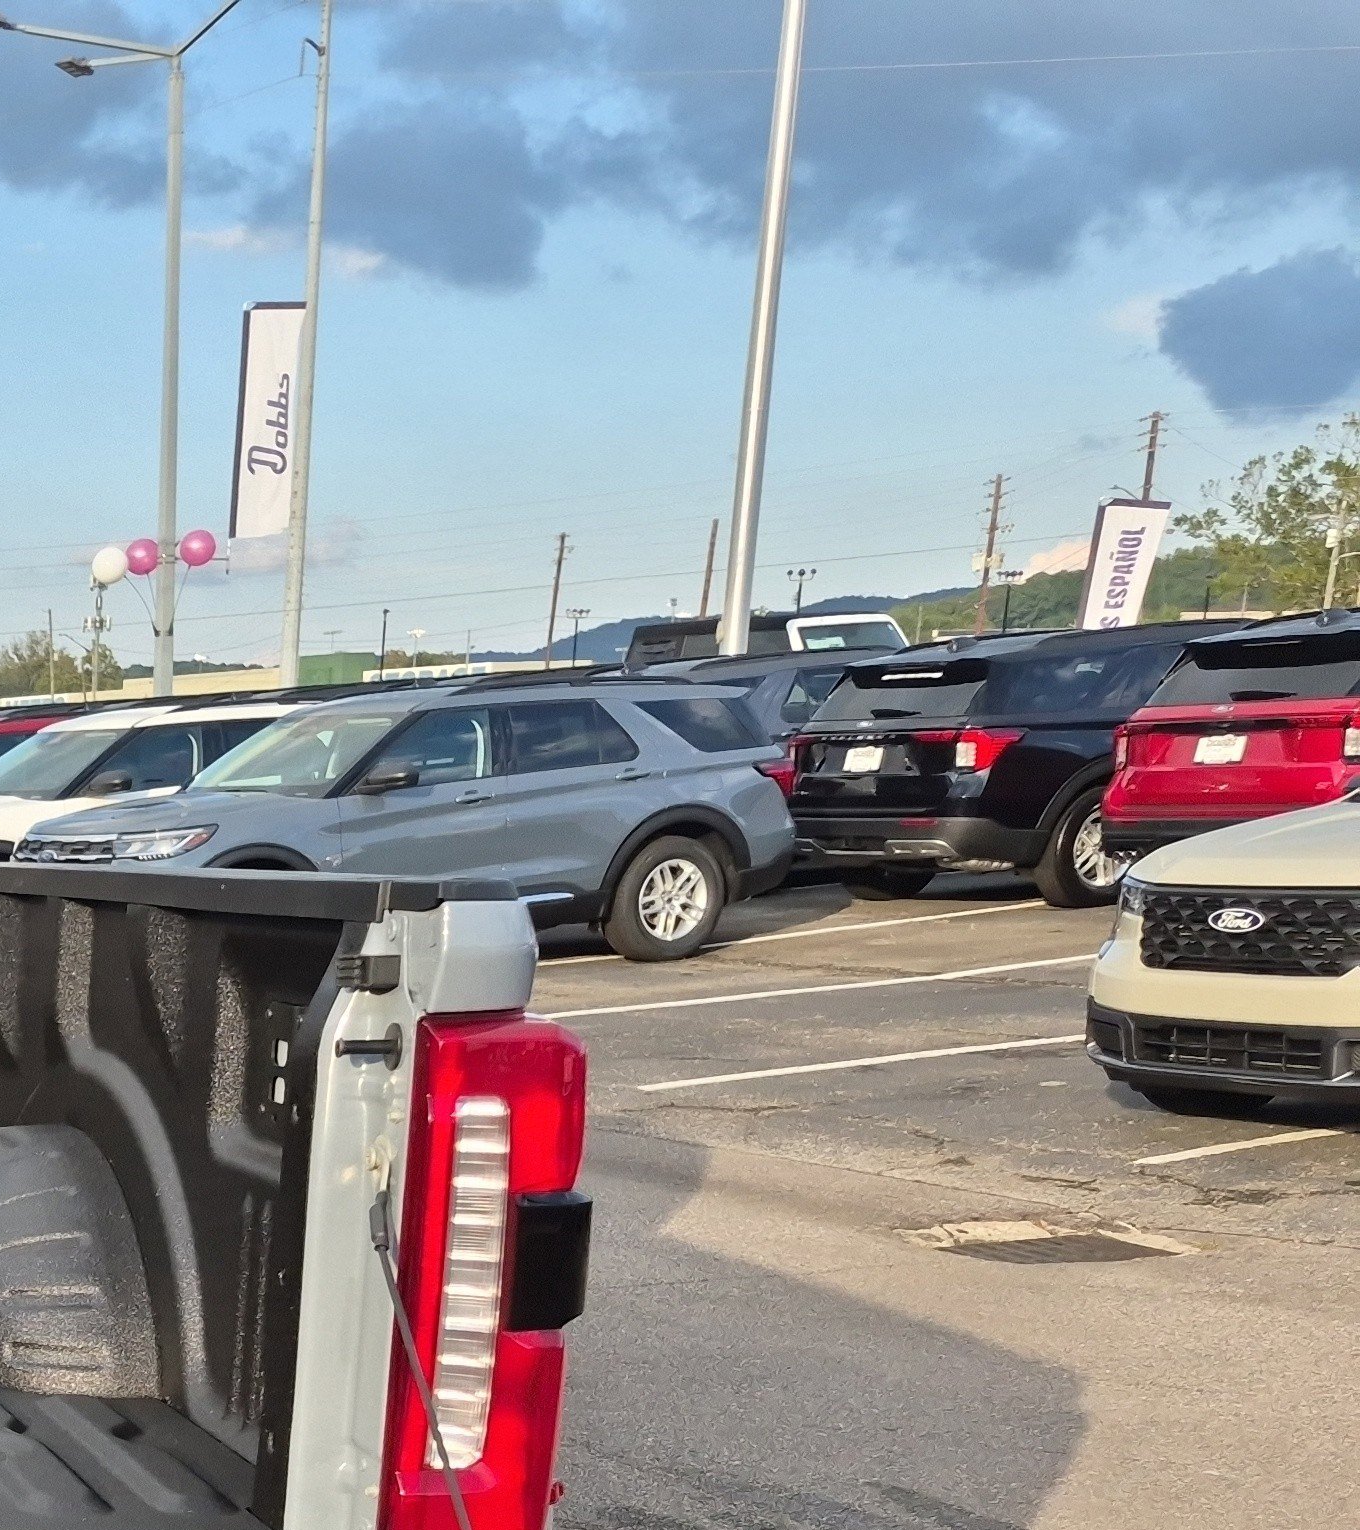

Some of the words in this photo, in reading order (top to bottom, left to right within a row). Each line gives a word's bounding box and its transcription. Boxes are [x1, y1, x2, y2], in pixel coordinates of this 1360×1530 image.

[246, 373, 290, 475] Dobbs
[1103, 526, 1147, 610] ESPAÑOL
[1217, 911, 1254, 929] Ford
